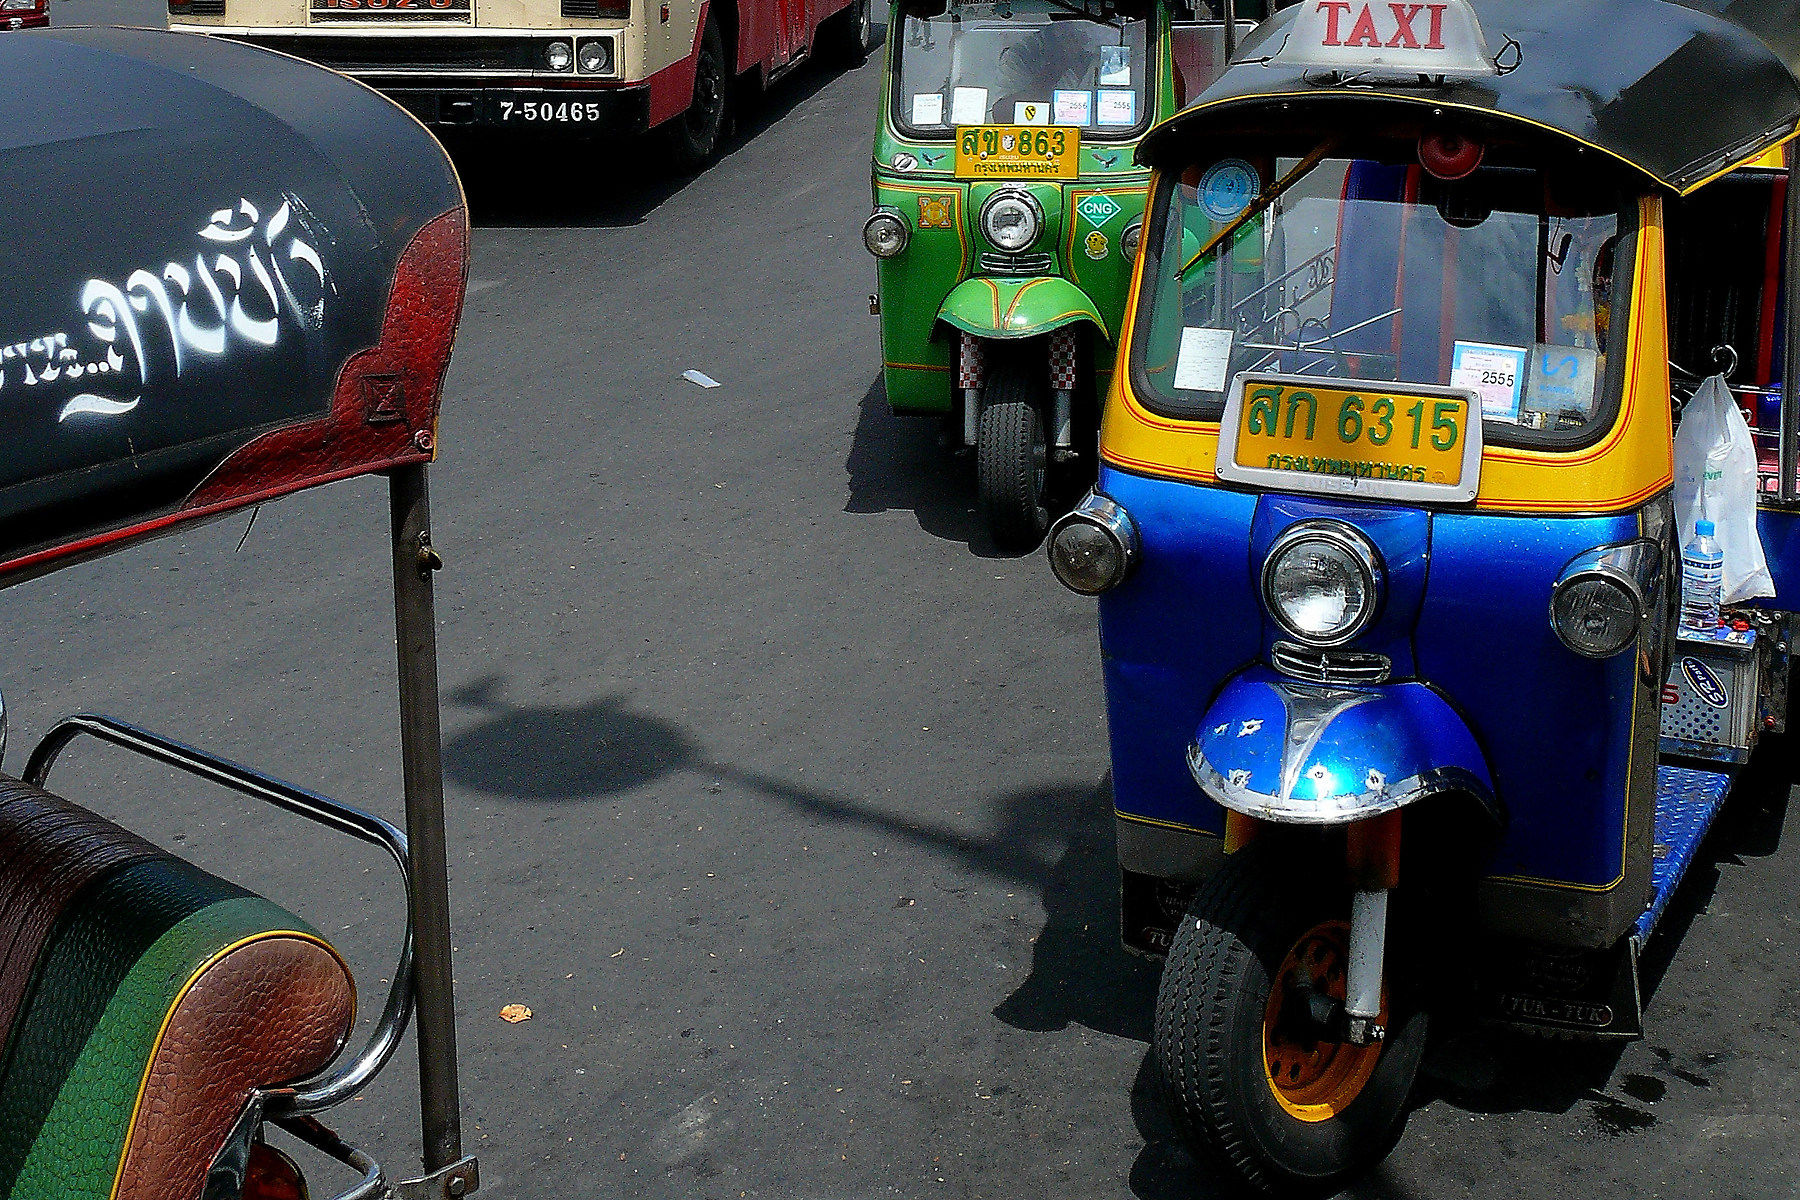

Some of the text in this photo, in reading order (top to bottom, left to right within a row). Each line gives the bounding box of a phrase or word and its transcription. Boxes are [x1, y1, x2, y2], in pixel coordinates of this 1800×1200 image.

[1316, 1, 1447, 50] TAXI
[500, 101, 600, 122] 7-50465
[1018, 130, 1065, 156] 863
[1083, 202, 1112, 215] CNG
[1481, 371, 1515, 388] 2555
[1248, 385, 1461, 452] สก 6315
